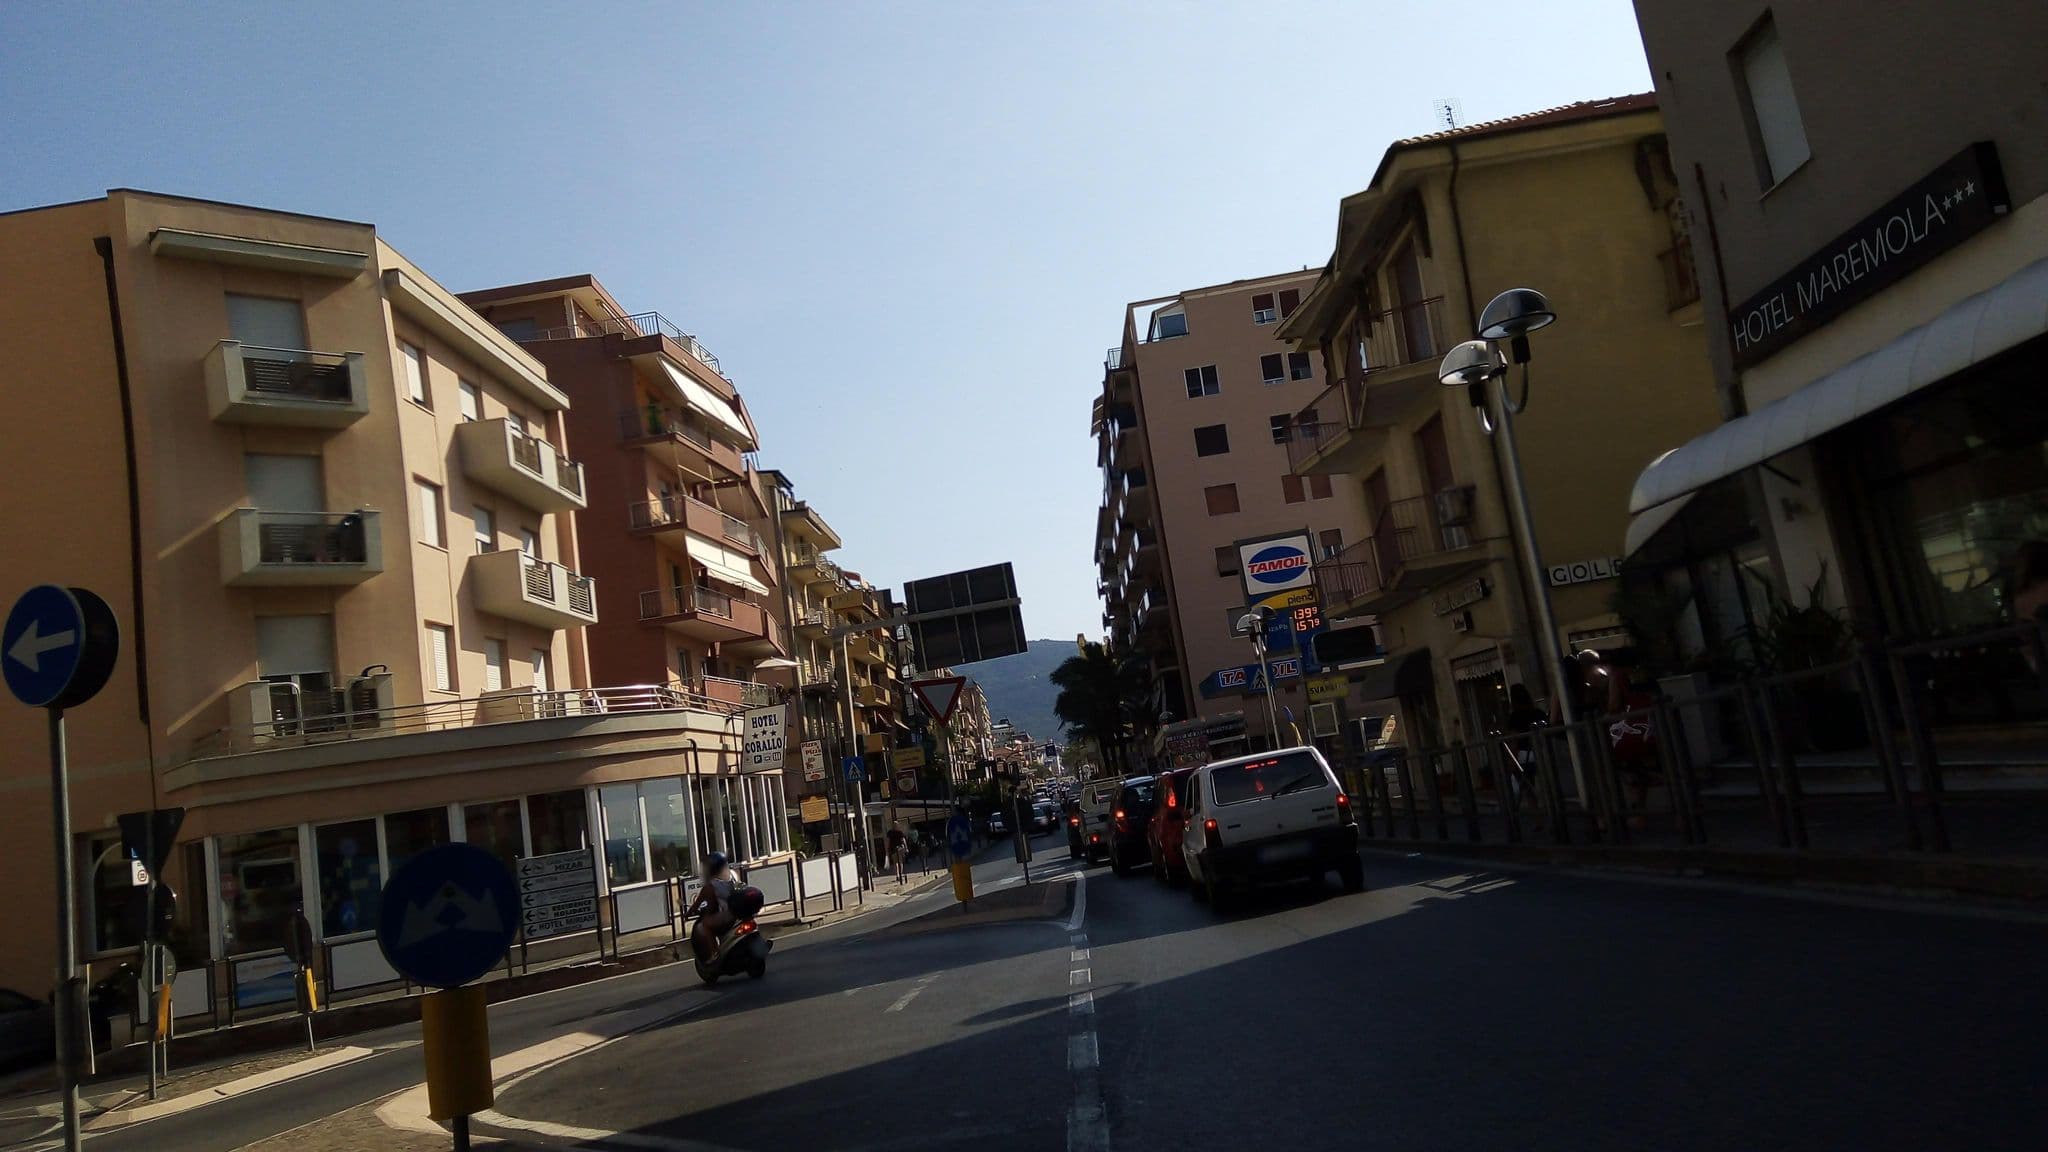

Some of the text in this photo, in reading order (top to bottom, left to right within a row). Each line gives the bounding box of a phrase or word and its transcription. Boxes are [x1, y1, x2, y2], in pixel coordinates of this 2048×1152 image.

[1733, 192, 1946, 353] HOTEL MAREMOLA
[1247, 555, 1308, 574] TAMOIL
[751, 713, 779, 729] HOTEL
[744, 737, 783, 754] CORALLO
[538, 920, 564, 930] HOTEL
